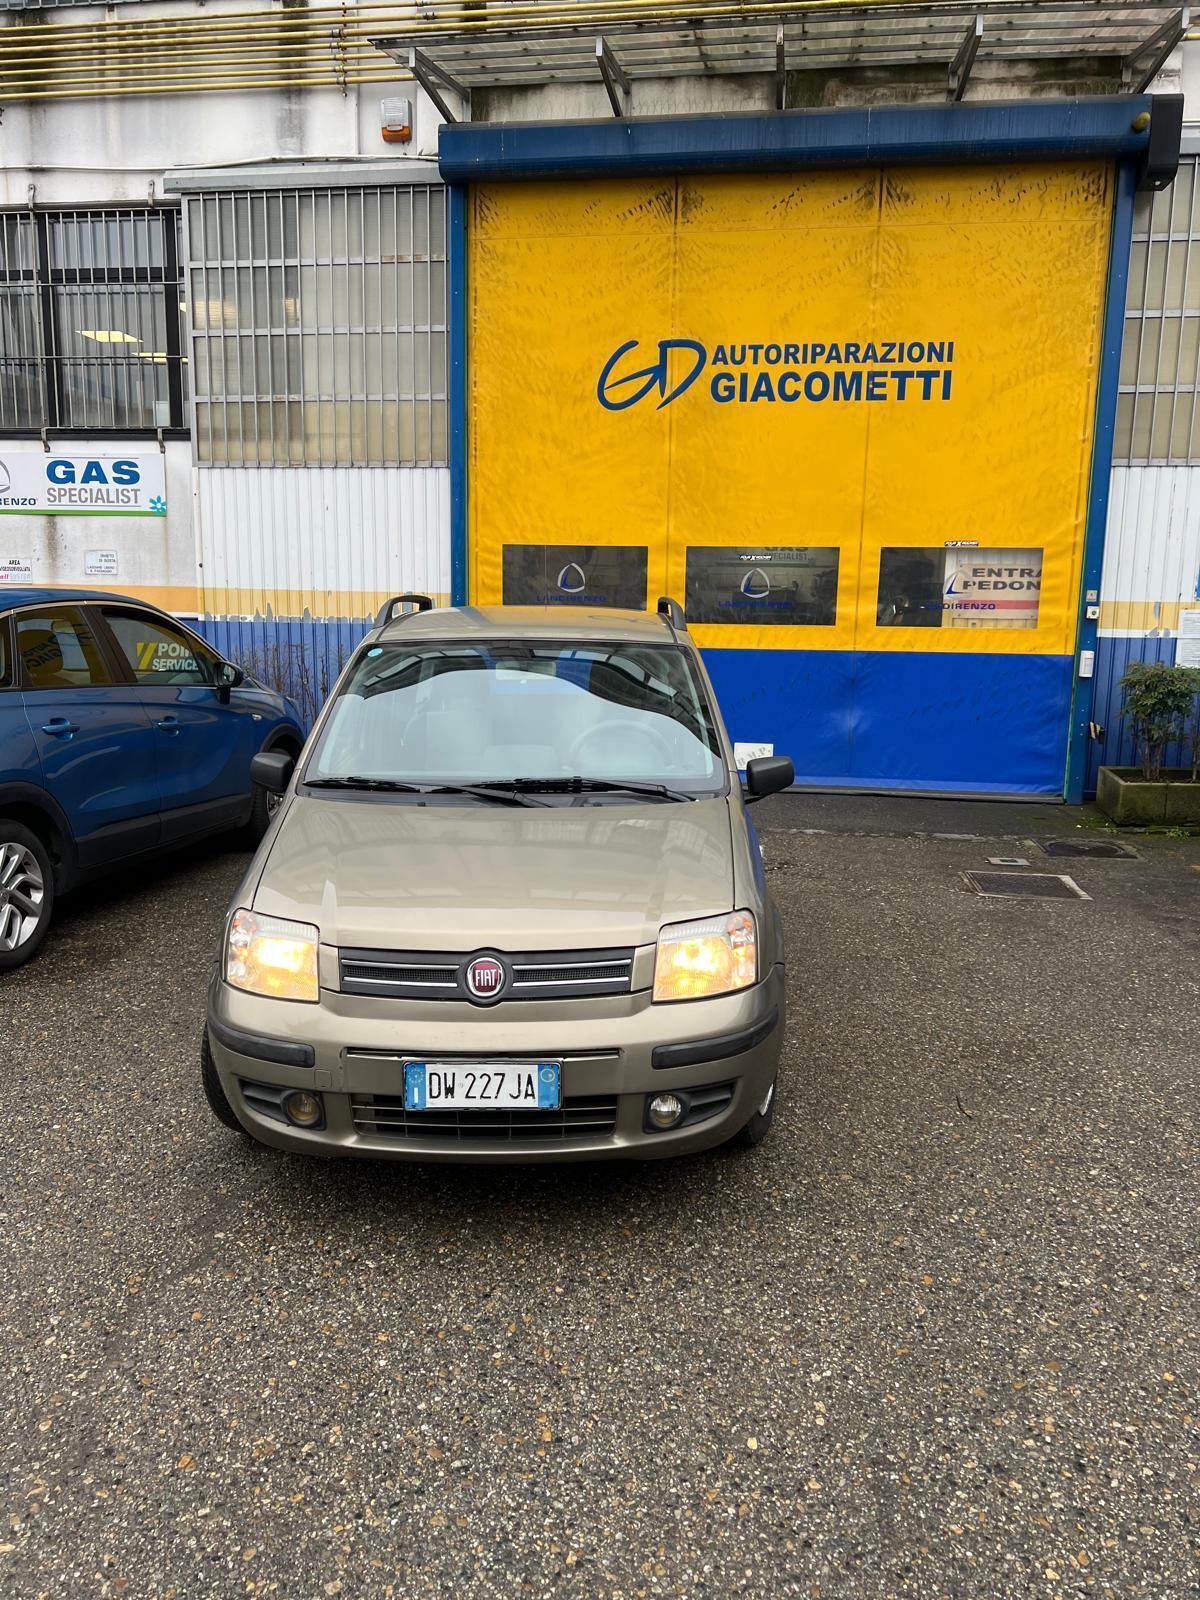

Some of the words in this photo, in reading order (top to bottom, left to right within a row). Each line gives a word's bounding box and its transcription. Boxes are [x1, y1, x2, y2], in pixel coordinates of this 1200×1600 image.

[711, 341, 954, 366] AUTORIPARAZIONI
[710, 370, 953, 403] GIACOMETTI
[46, 460, 141, 485] GAS
[46, 487, 141, 504] SPECIALIST
[475, 968, 498, 987] FIAT
[428, 1072, 456, 1100] DW
